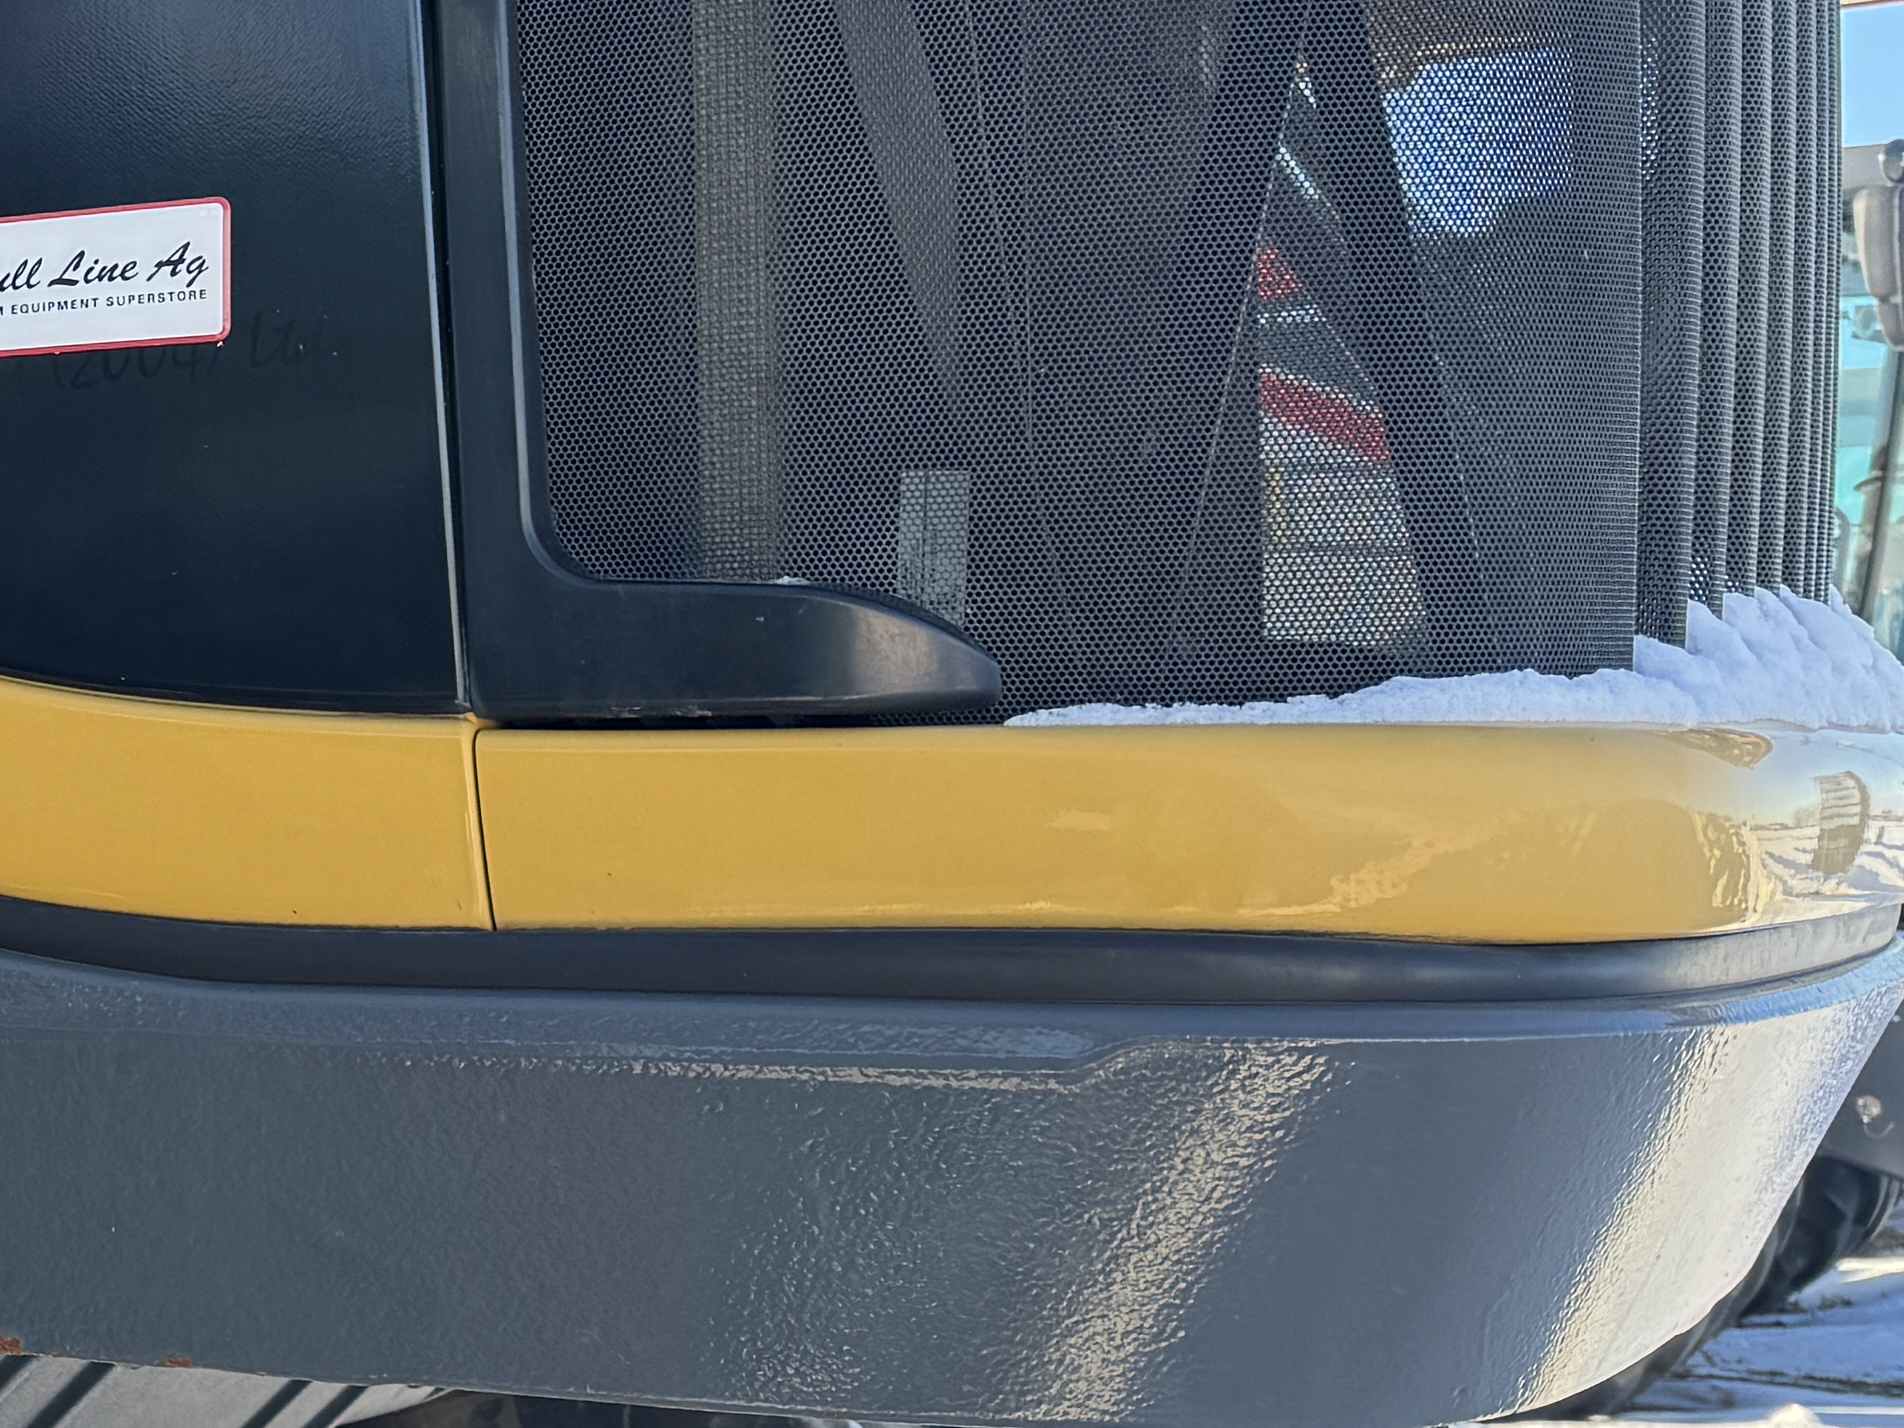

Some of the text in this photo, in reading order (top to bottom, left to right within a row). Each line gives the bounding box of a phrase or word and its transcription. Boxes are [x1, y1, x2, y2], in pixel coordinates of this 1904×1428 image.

[47, 250, 139, 286] Line
[146, 240, 209, 288] Ag
[11, 297, 100, 316] EQUIPMENT
[106, 288, 208, 308] SUPERSTORE
